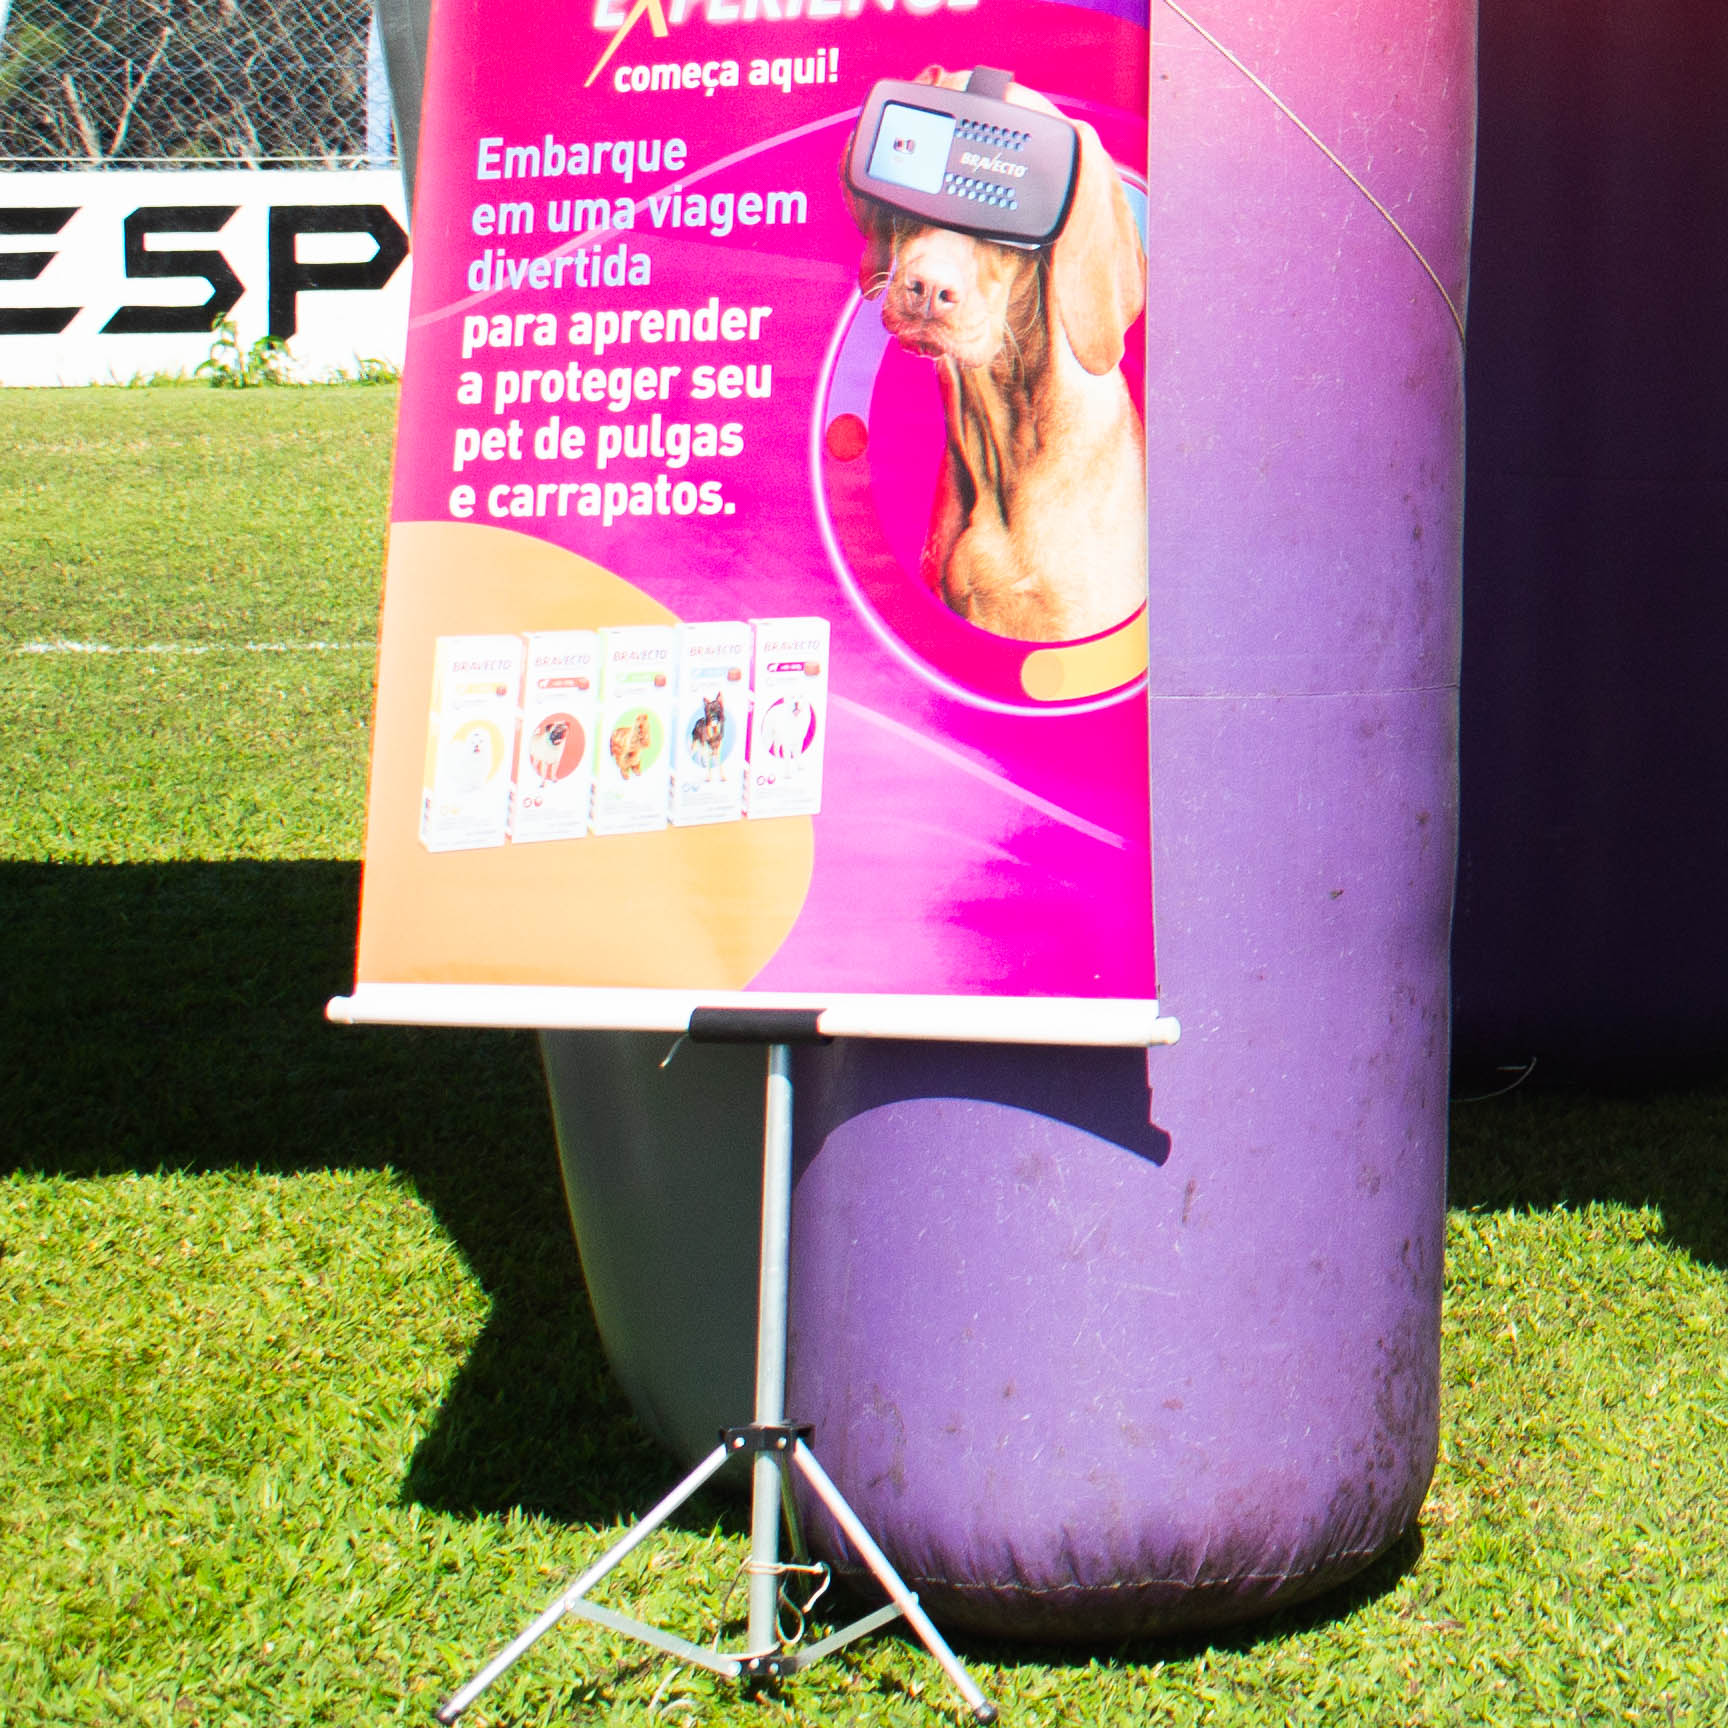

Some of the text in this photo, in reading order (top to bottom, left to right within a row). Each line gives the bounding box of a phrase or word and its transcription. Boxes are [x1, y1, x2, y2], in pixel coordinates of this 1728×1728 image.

[614, 48, 839, 97] começa aqui!
[477, 134, 688, 183] Embarque
[472, 188, 808, 239] em uma viagem
[467, 244, 652, 292] divertida
[462, 297, 773, 359] para aprender
[457, 362, 772, 415] a proteger seu
[453, 414, 745, 471] pet de pulgas
[449, 476, 736, 526] e carrapatos.
